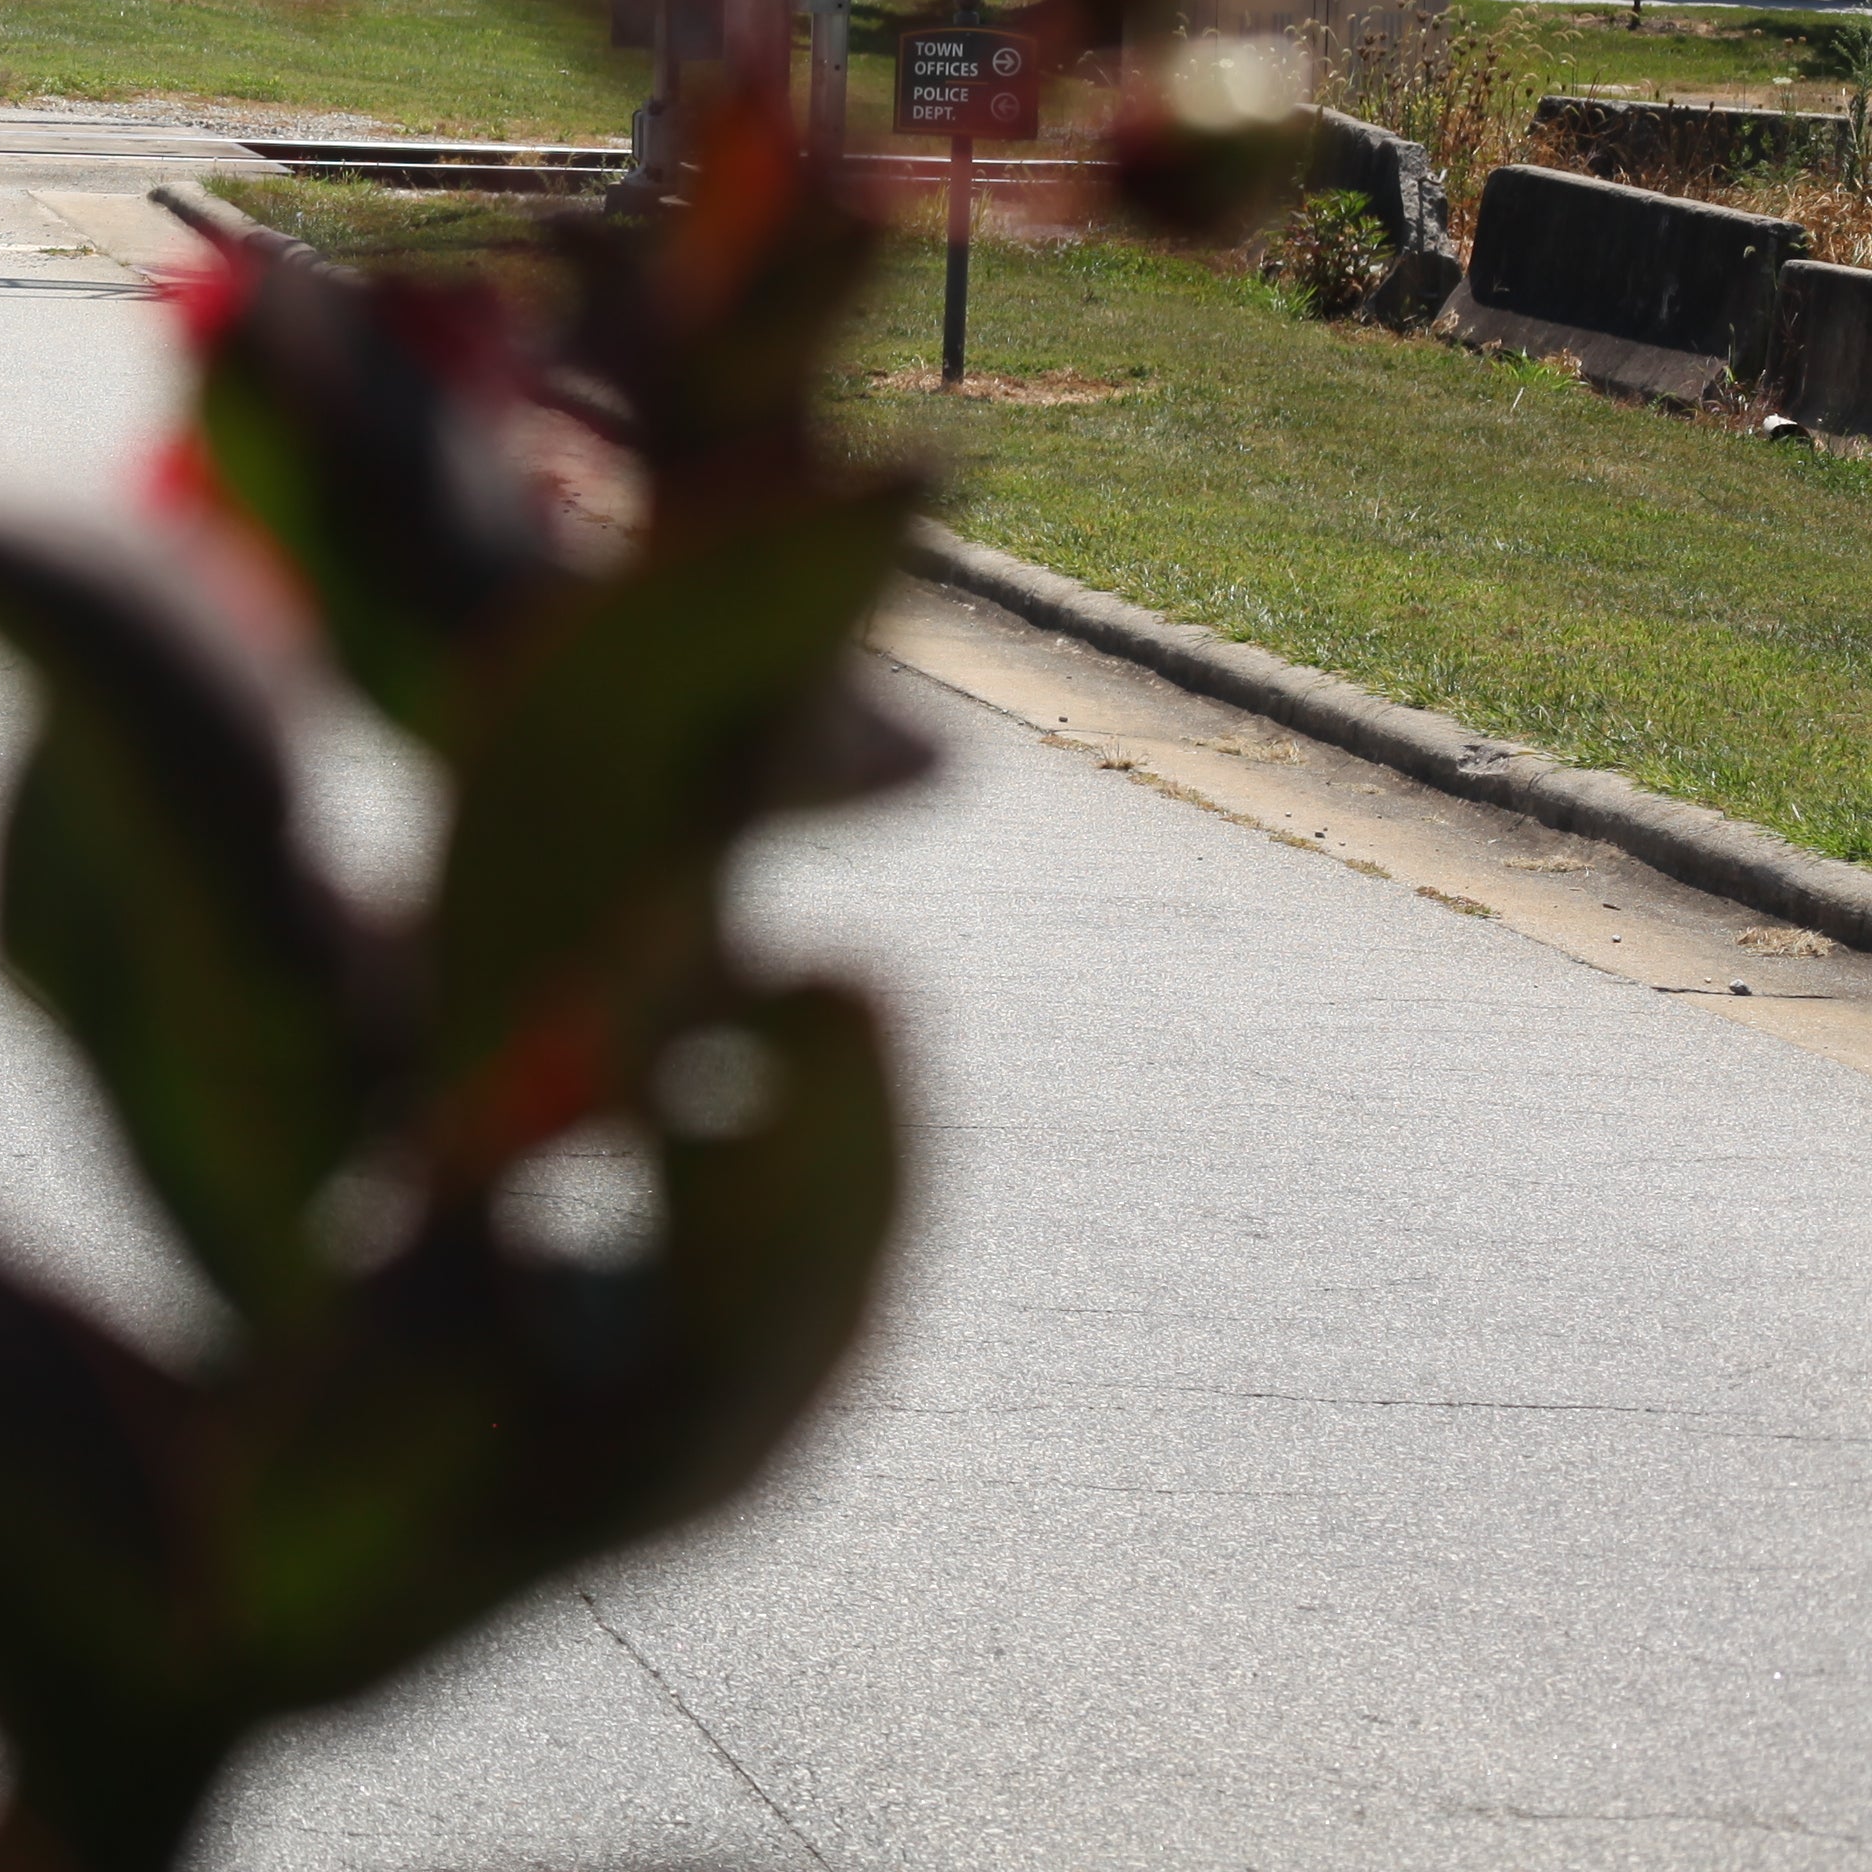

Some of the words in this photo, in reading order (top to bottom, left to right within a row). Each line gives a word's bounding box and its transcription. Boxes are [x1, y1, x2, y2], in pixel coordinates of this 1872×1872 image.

[915, 42, 963, 57] TOWN
[914, 61, 979, 76] OFFICES
[913, 86, 969, 102] POLICE
[912, 105, 956, 120] DEPT.
